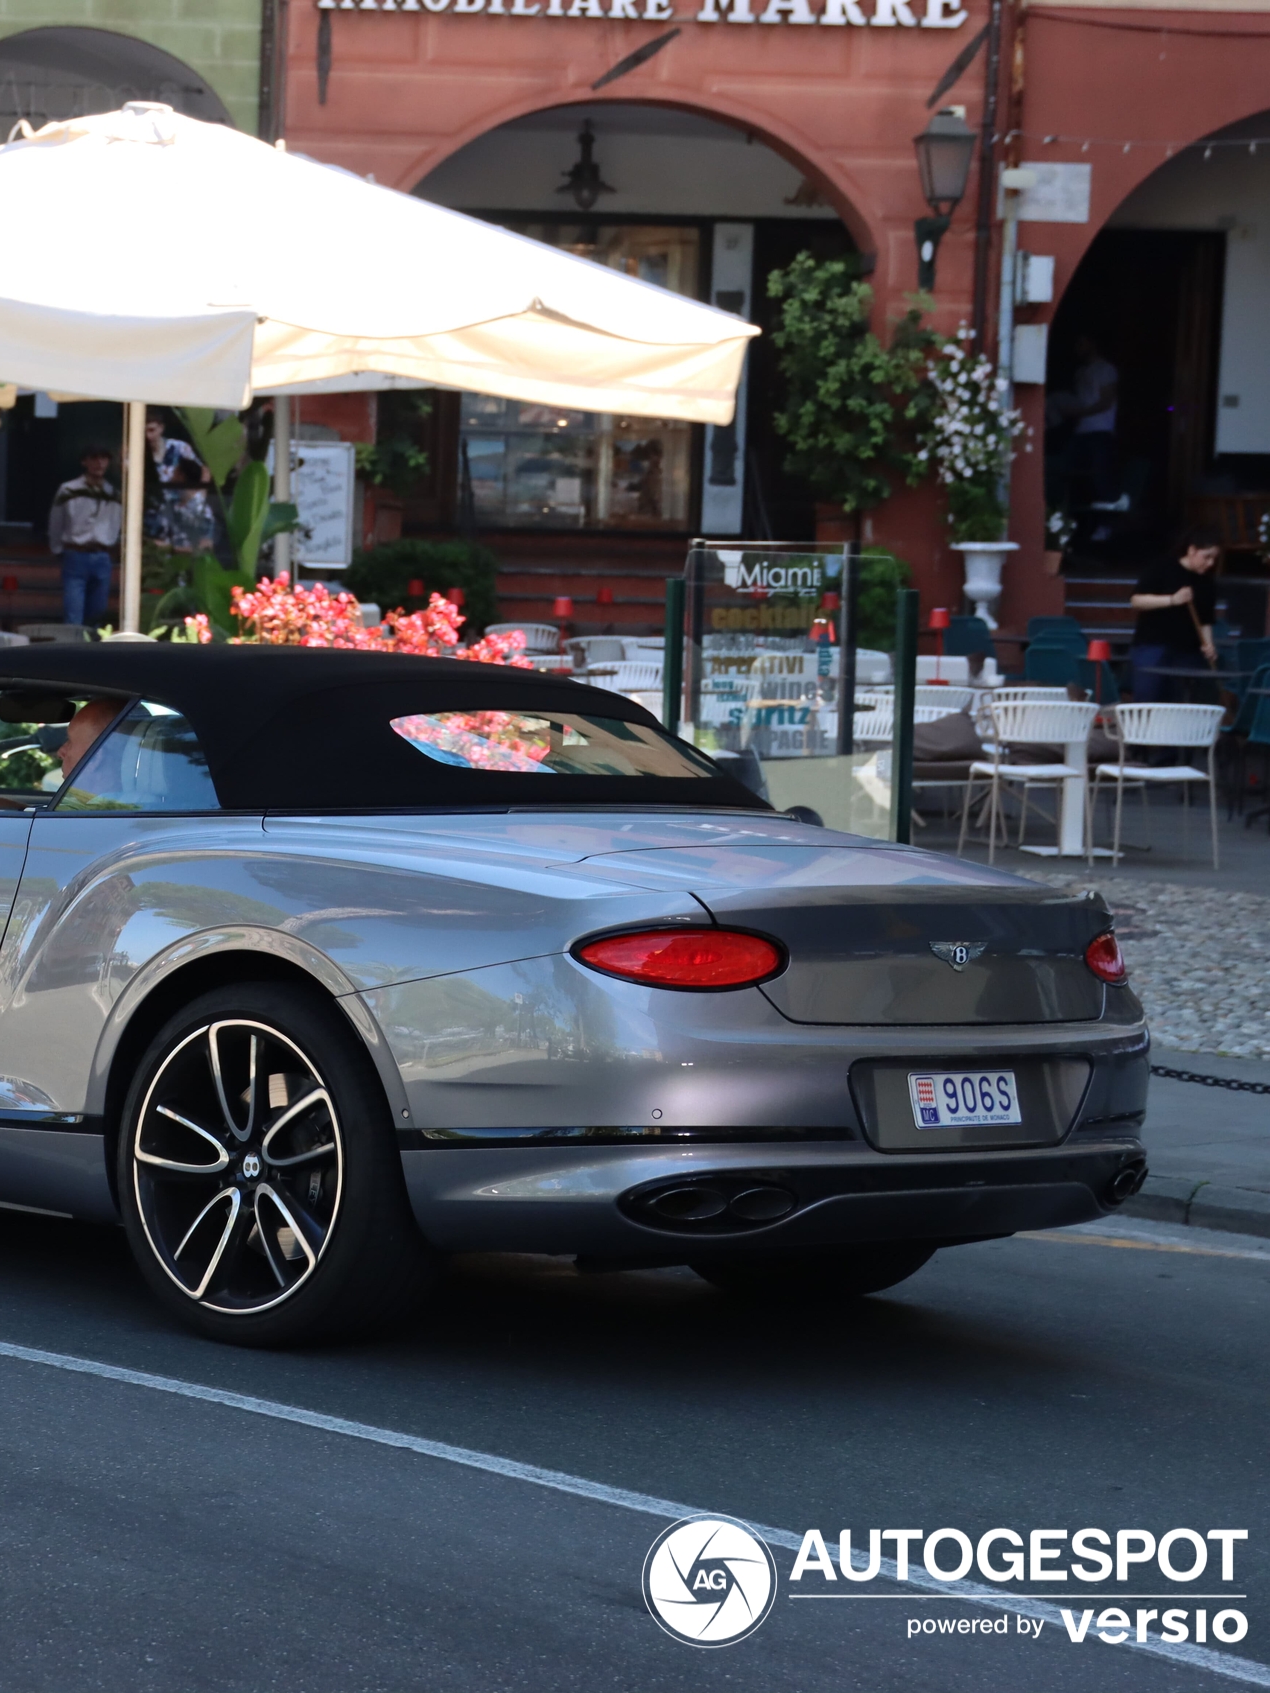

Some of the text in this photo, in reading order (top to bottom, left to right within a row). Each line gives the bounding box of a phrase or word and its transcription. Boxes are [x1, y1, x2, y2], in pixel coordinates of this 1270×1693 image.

[737, 561, 819, 588] Miami
[942, 1075, 1012, 1115] 906S
[923, 1110, 935, 1121] MC
